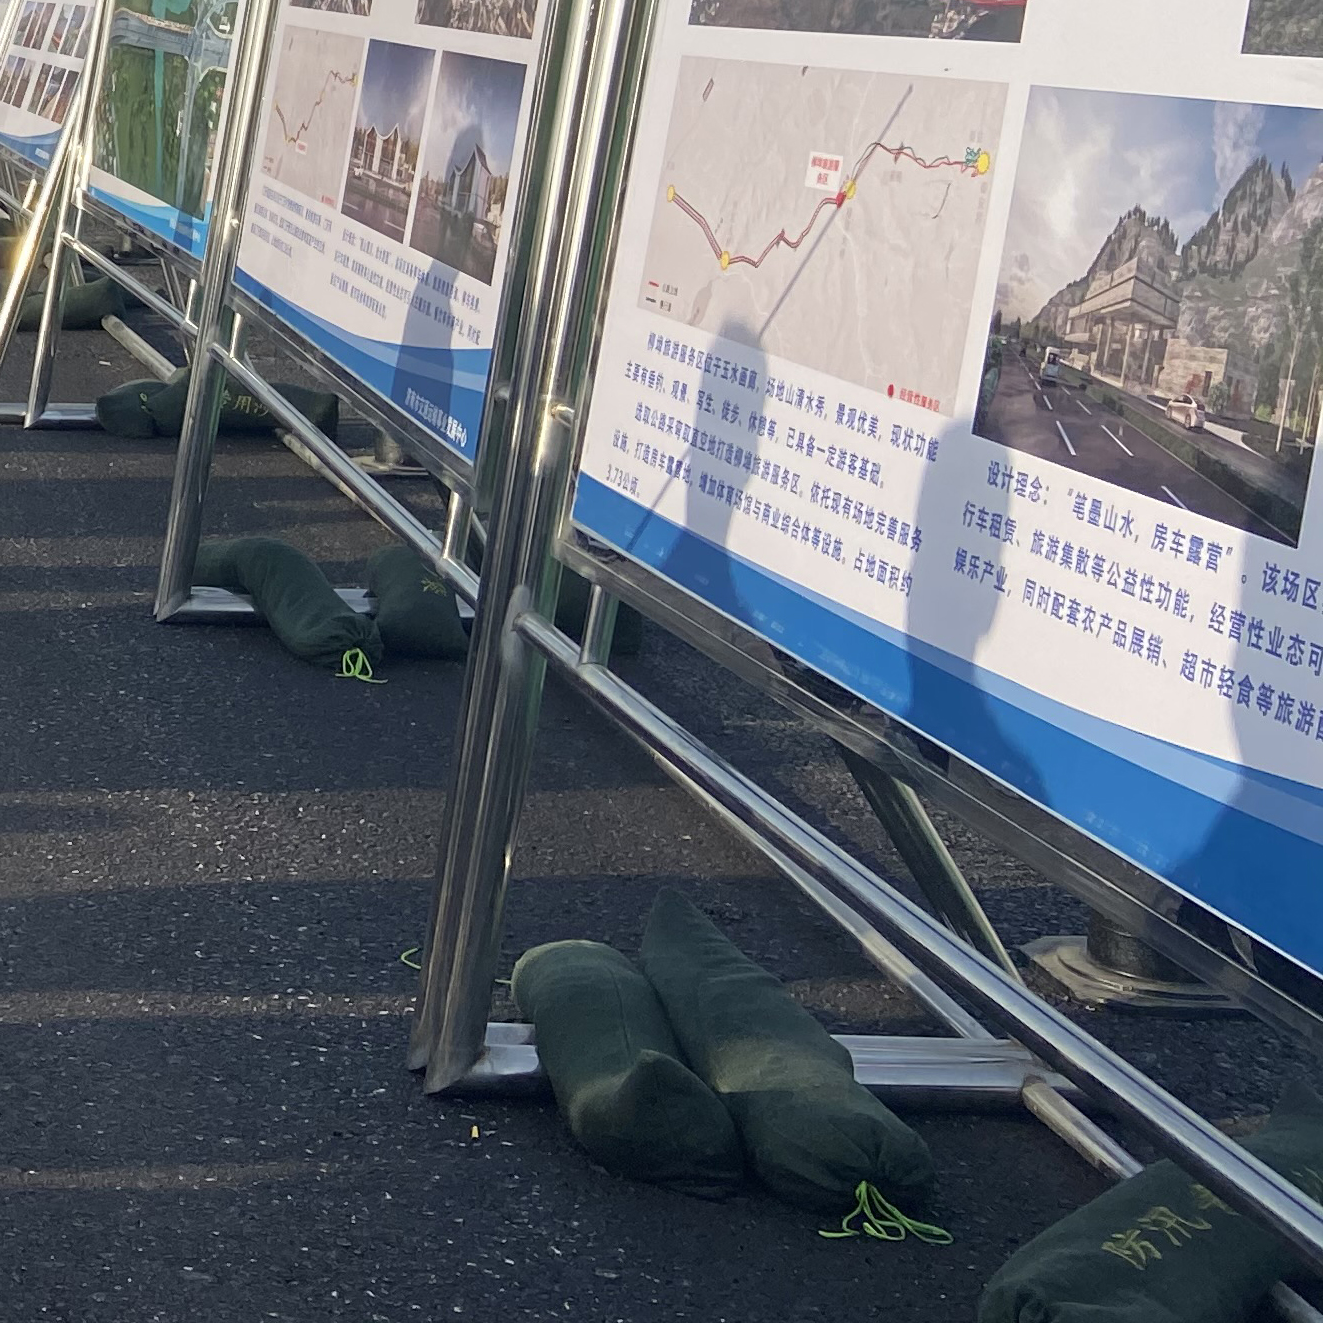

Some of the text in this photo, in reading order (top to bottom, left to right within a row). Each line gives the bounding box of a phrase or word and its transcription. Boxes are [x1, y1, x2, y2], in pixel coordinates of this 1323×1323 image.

[986, 459, 1323, 614] 设计理念：“笔墨山水，房车露营”。该场区
